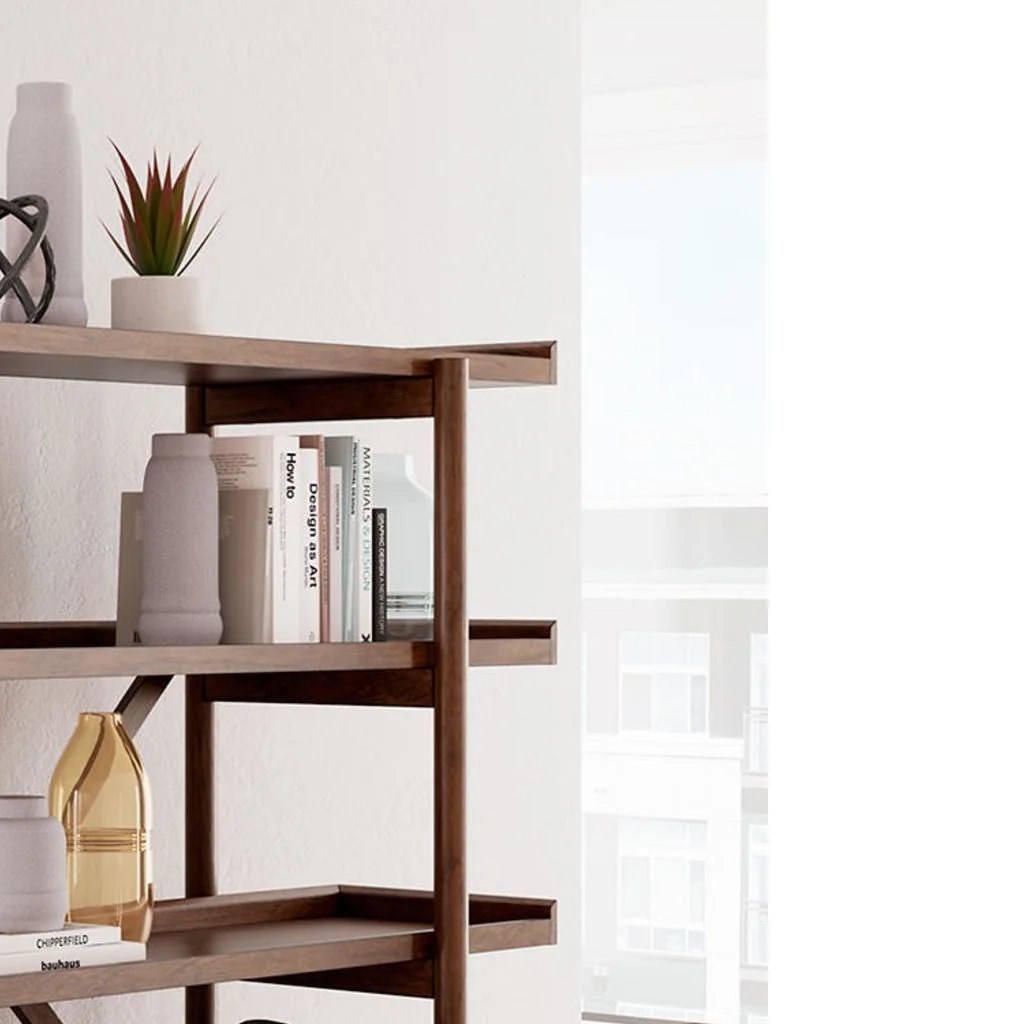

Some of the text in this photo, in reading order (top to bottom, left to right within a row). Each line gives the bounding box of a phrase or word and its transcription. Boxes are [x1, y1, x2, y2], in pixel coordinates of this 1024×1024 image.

[285, 452, 296, 499] How to
[307, 483, 318, 588] Design as Art
[362, 447, 371, 592] MATERIALS & DESIGN
[377, 513, 385, 547] GRAPHIC
[36, 934, 89, 949] CHIPPERFIELD
[41, 959, 81, 971] bauhaus
